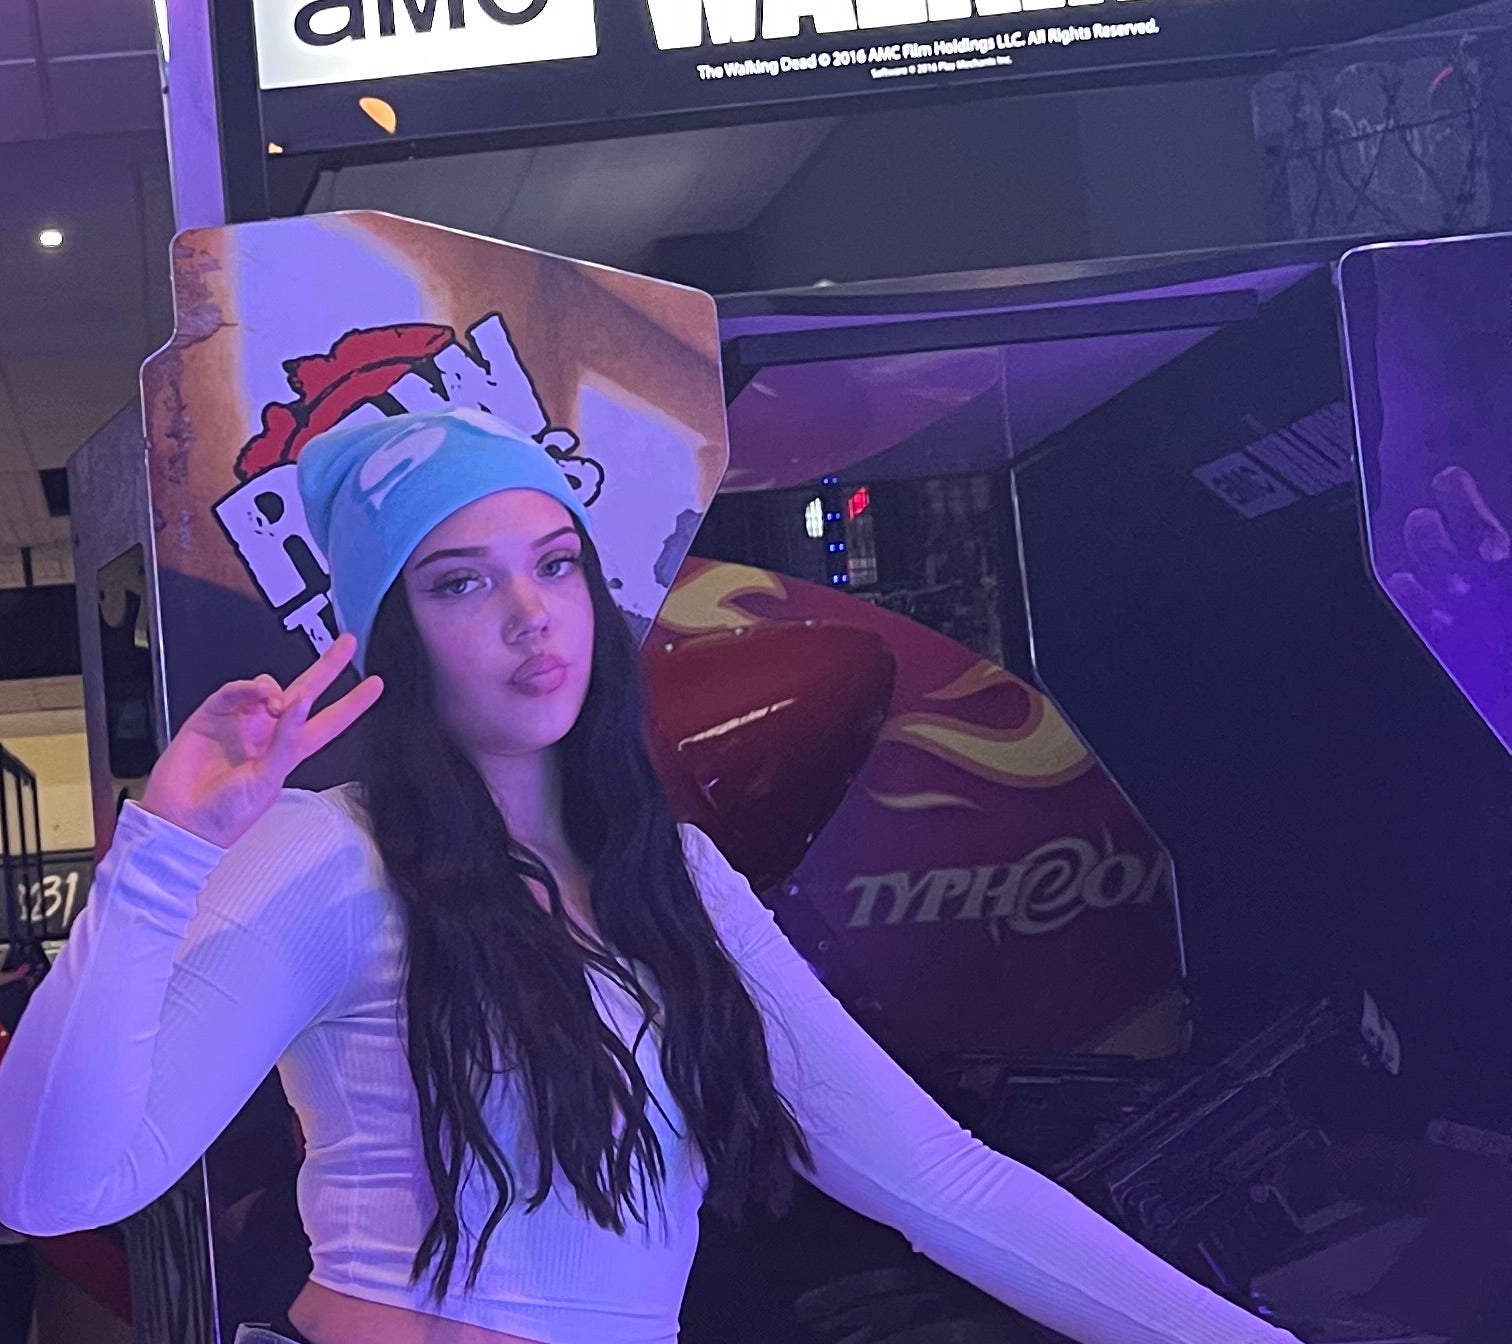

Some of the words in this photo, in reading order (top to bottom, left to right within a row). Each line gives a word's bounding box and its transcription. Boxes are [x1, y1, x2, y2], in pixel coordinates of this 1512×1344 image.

[696, 64, 724, 80] The
[724, 59, 779, 77] Walking
[780, 53, 817, 72] Dead
[832, 48, 867, 66] 2016
[868, 44, 901, 62] AMC
[902, 42, 932, 58] Film
[933, 36, 995, 55] Holdings
[996, 32, 1025, 50] LLC.
[1027, 28, 1046, 46] All
[1047, 26, 1092, 45] Rights
[1092, 18, 1160, 39] Reserved.
